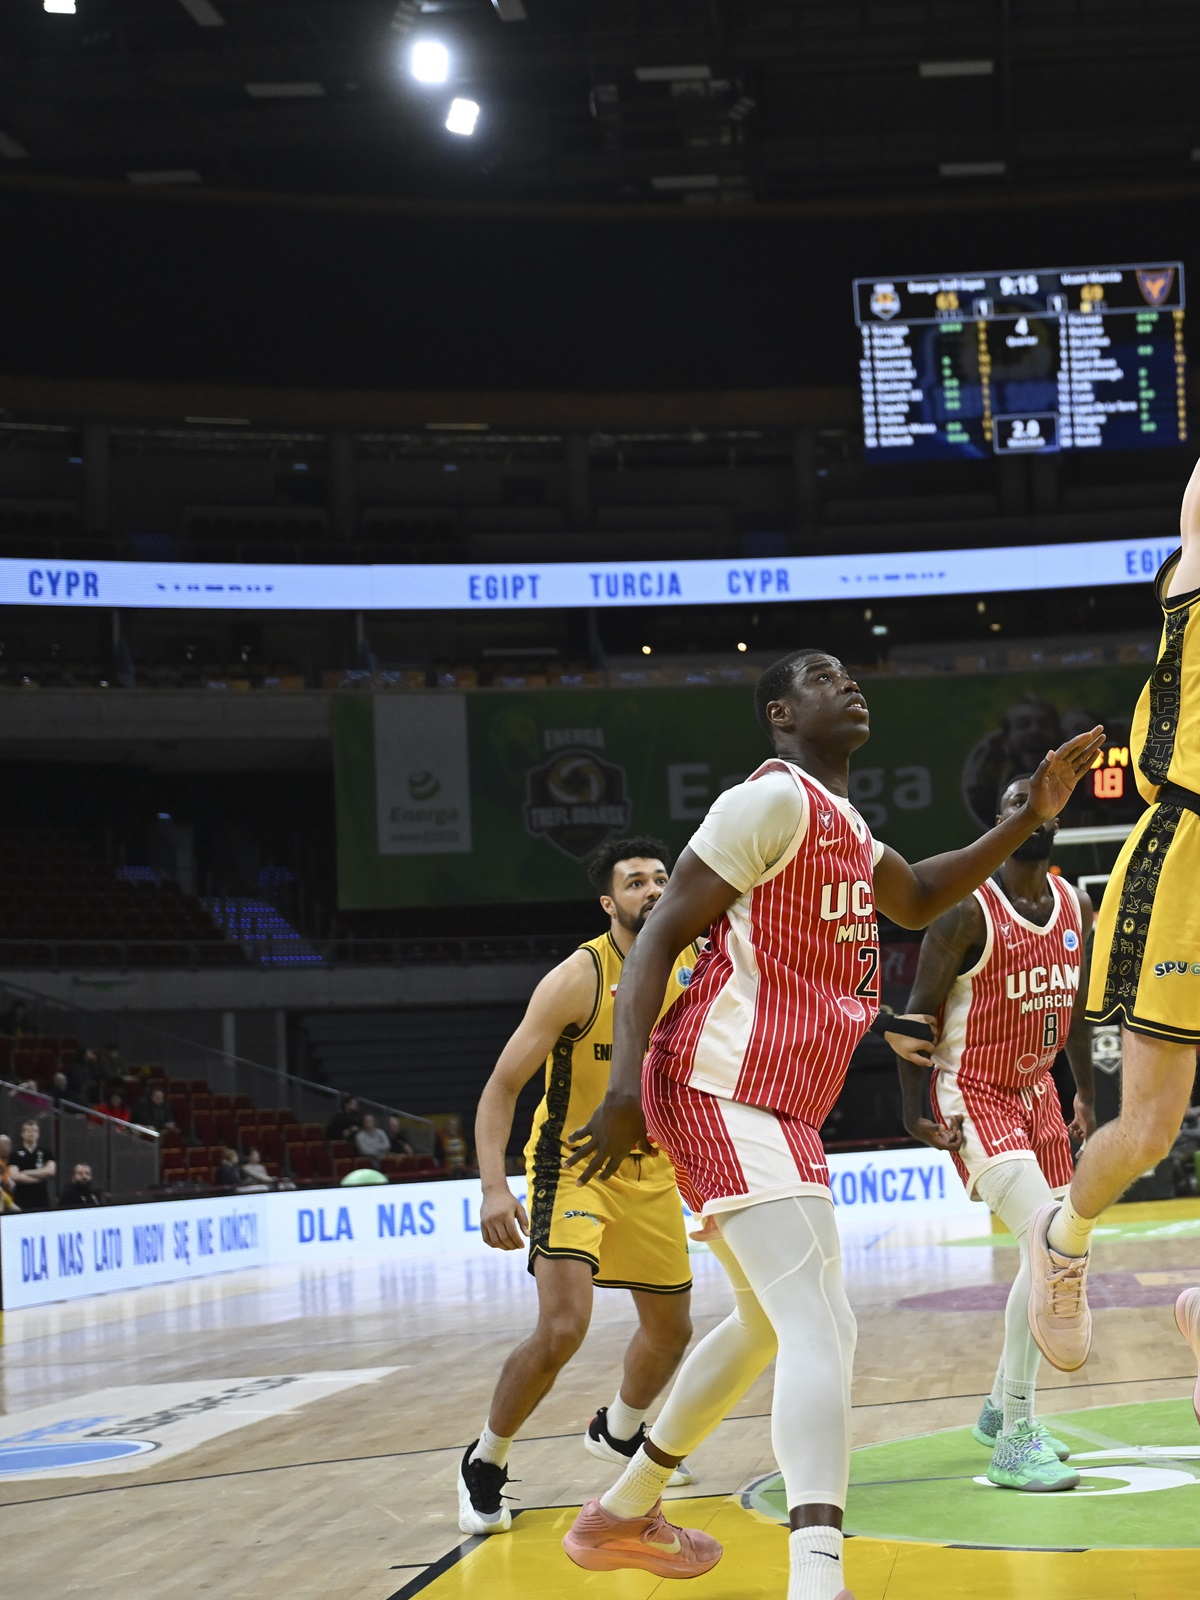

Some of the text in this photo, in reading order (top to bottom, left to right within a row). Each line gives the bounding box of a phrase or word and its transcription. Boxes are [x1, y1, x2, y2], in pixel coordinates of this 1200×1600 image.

[28, 568, 100, 598] CYPR
[469, 568, 790, 600] EGIPT TURCJA CYPR
[390, 807, 459, 827] Energa
[854, 947, 878, 997] 2
[1006, 964, 1080, 1000] UCAM
[1153, 960, 1189, 979] SPY
[1021, 994, 1074, 1015] MURCIA
[1043, 1013, 1058, 1047] 8
[594, 1043, 612, 1061] EN
[830, 1162, 945, 1206] KOŃCZY!
[299, 1205, 354, 1243] DLA
[378, 1200, 435, 1238] NAS
[21, 1235, 48, 1283] DLA
[57, 1230, 84, 1277] NAS
[93, 1227, 122, 1273] LATO
